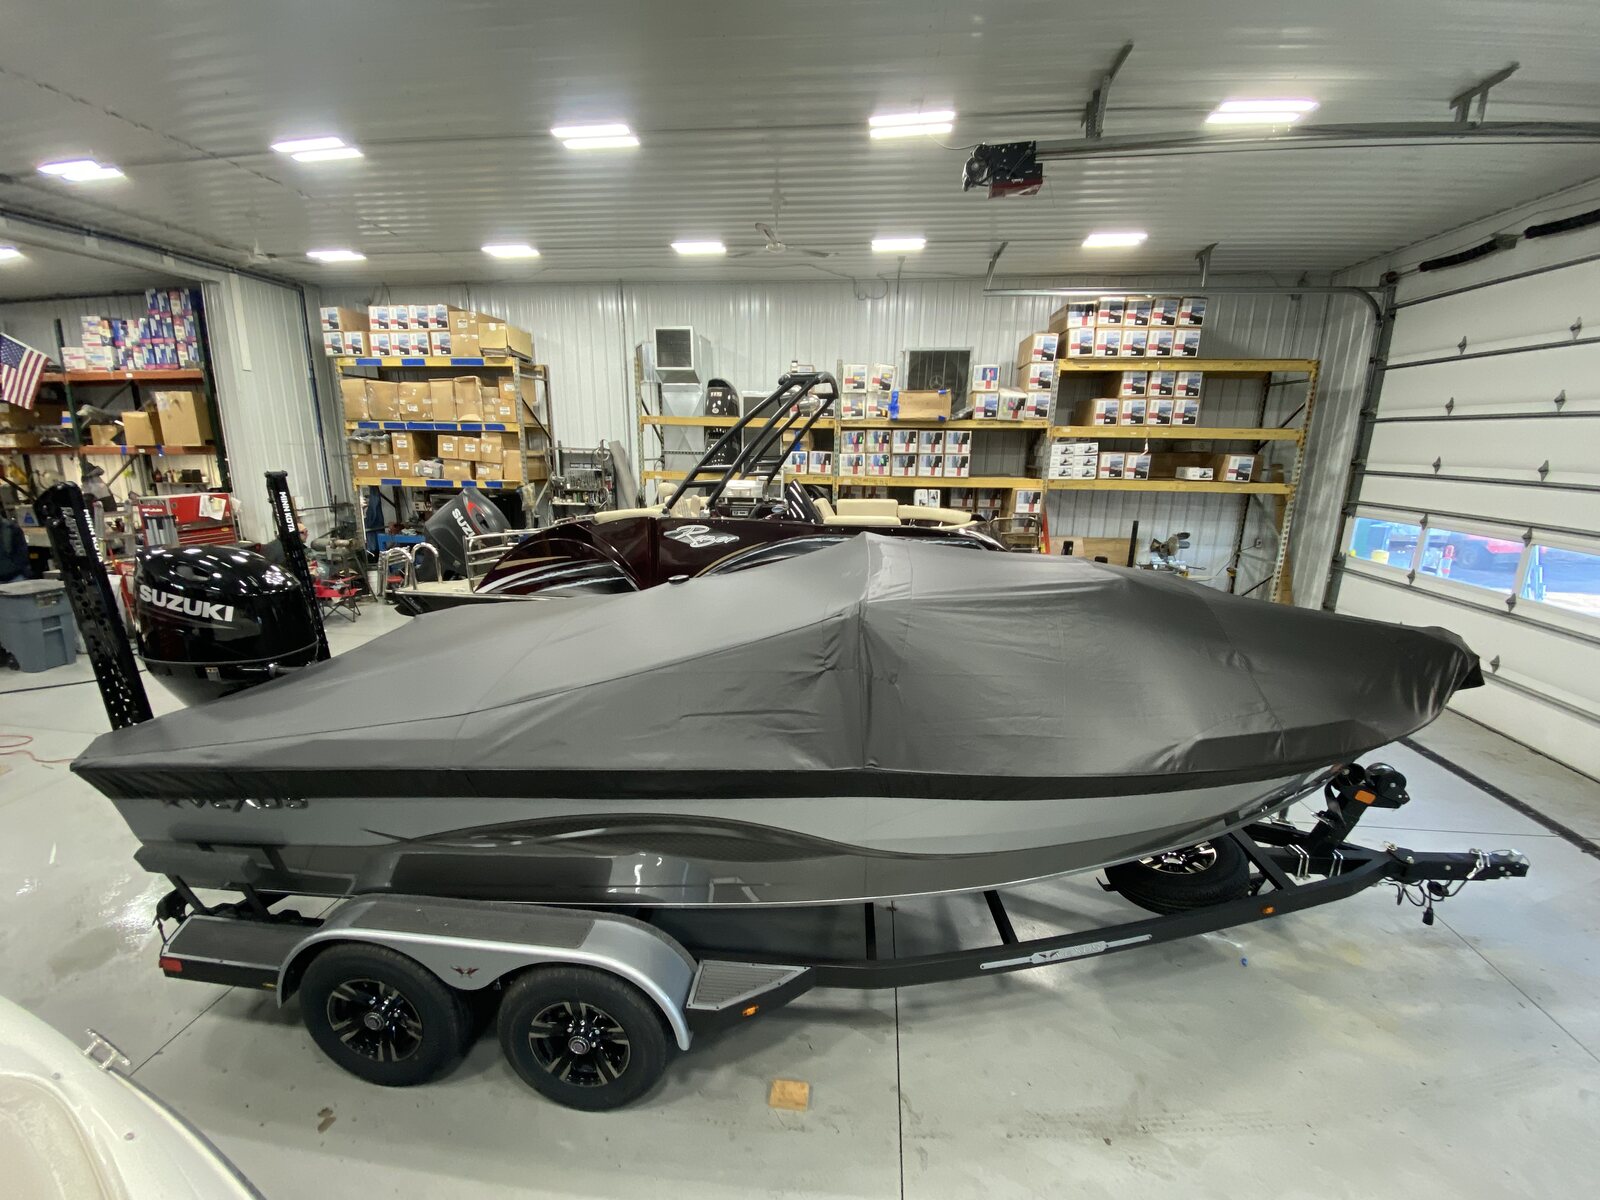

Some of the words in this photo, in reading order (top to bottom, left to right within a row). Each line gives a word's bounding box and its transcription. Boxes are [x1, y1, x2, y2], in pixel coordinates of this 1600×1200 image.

[279, 491, 291, 512] MINN
[83, 508, 96, 536] MINN
[284, 512, 296, 533] KOTA
[139, 584, 235, 622] SUZUKI
